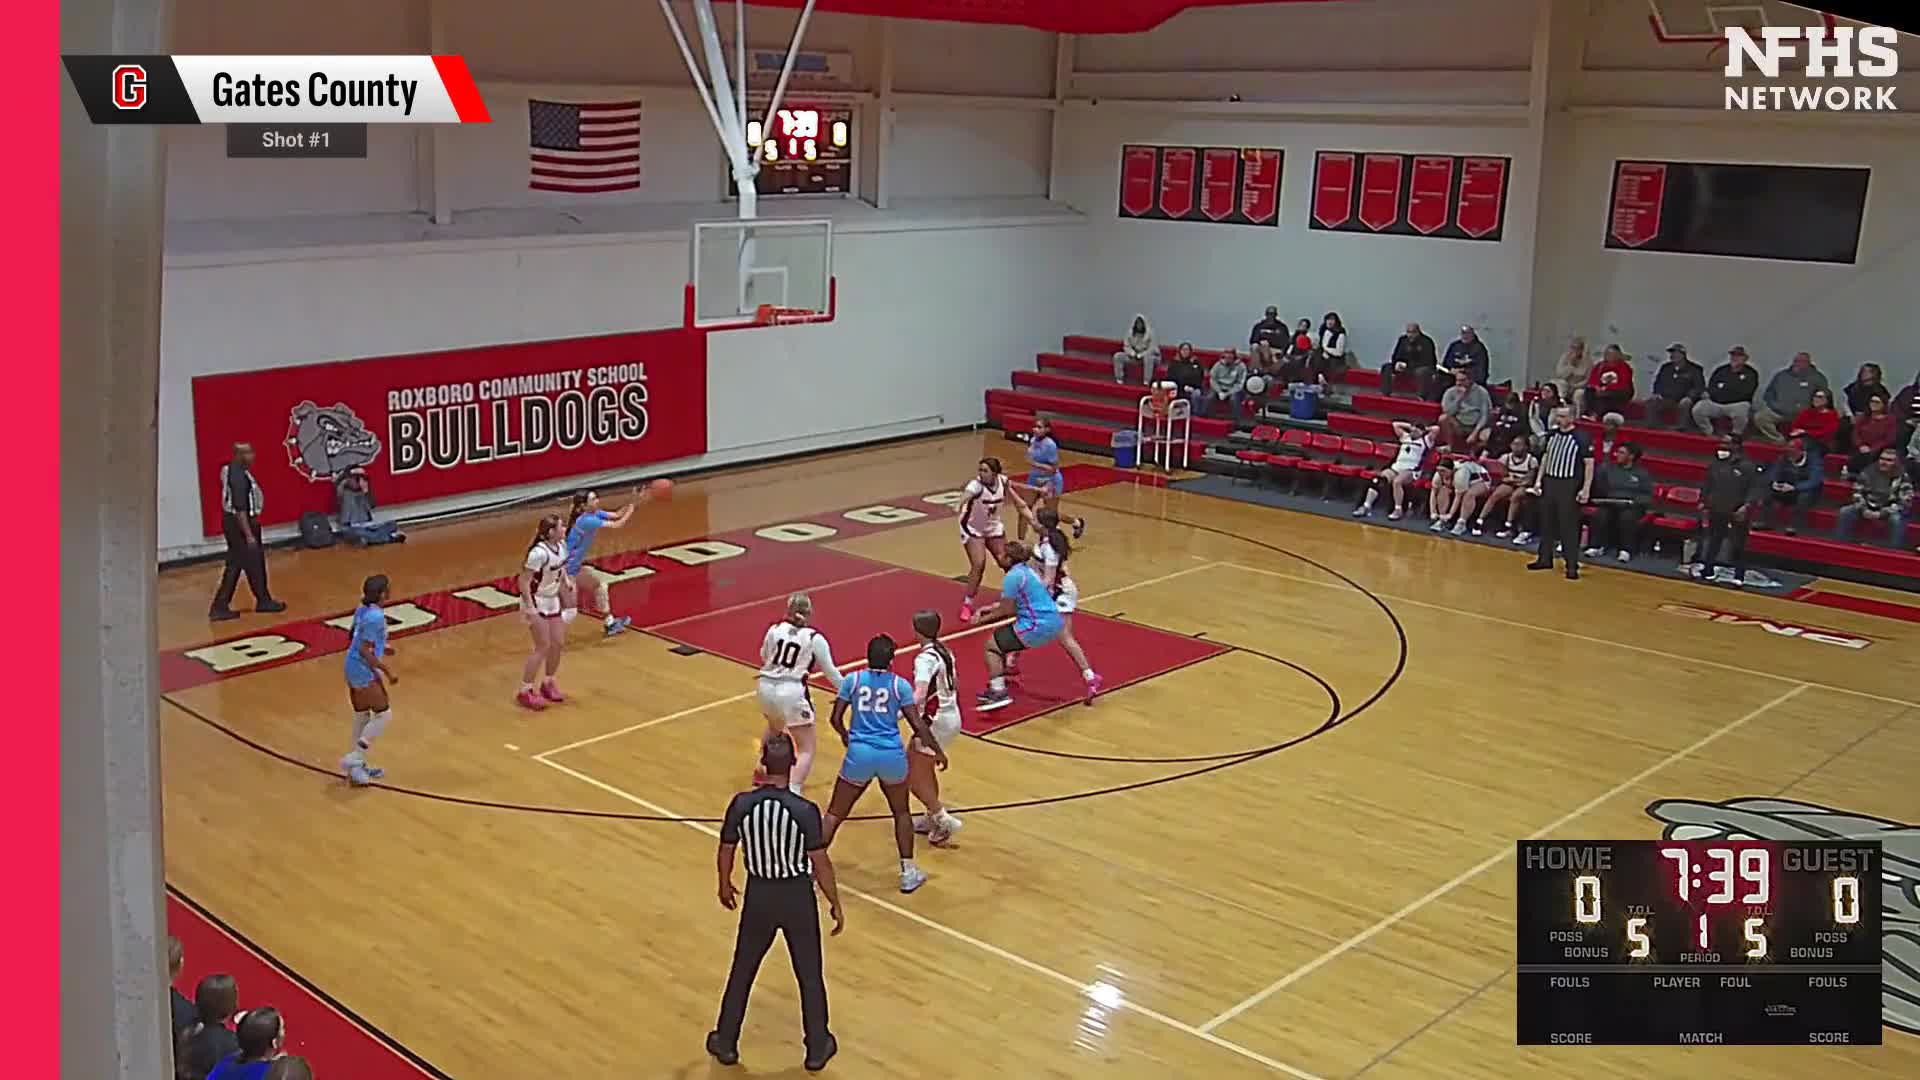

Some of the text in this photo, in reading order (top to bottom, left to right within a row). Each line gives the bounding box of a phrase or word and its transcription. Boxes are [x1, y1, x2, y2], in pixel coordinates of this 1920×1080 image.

[388, 362, 648, 410] ROXBORO COMMUNITY SCHOOL
[388, 383, 649, 474] BULLDOGS
[771, 638, 802, 669] 10
[858, 685, 890, 713] 22
